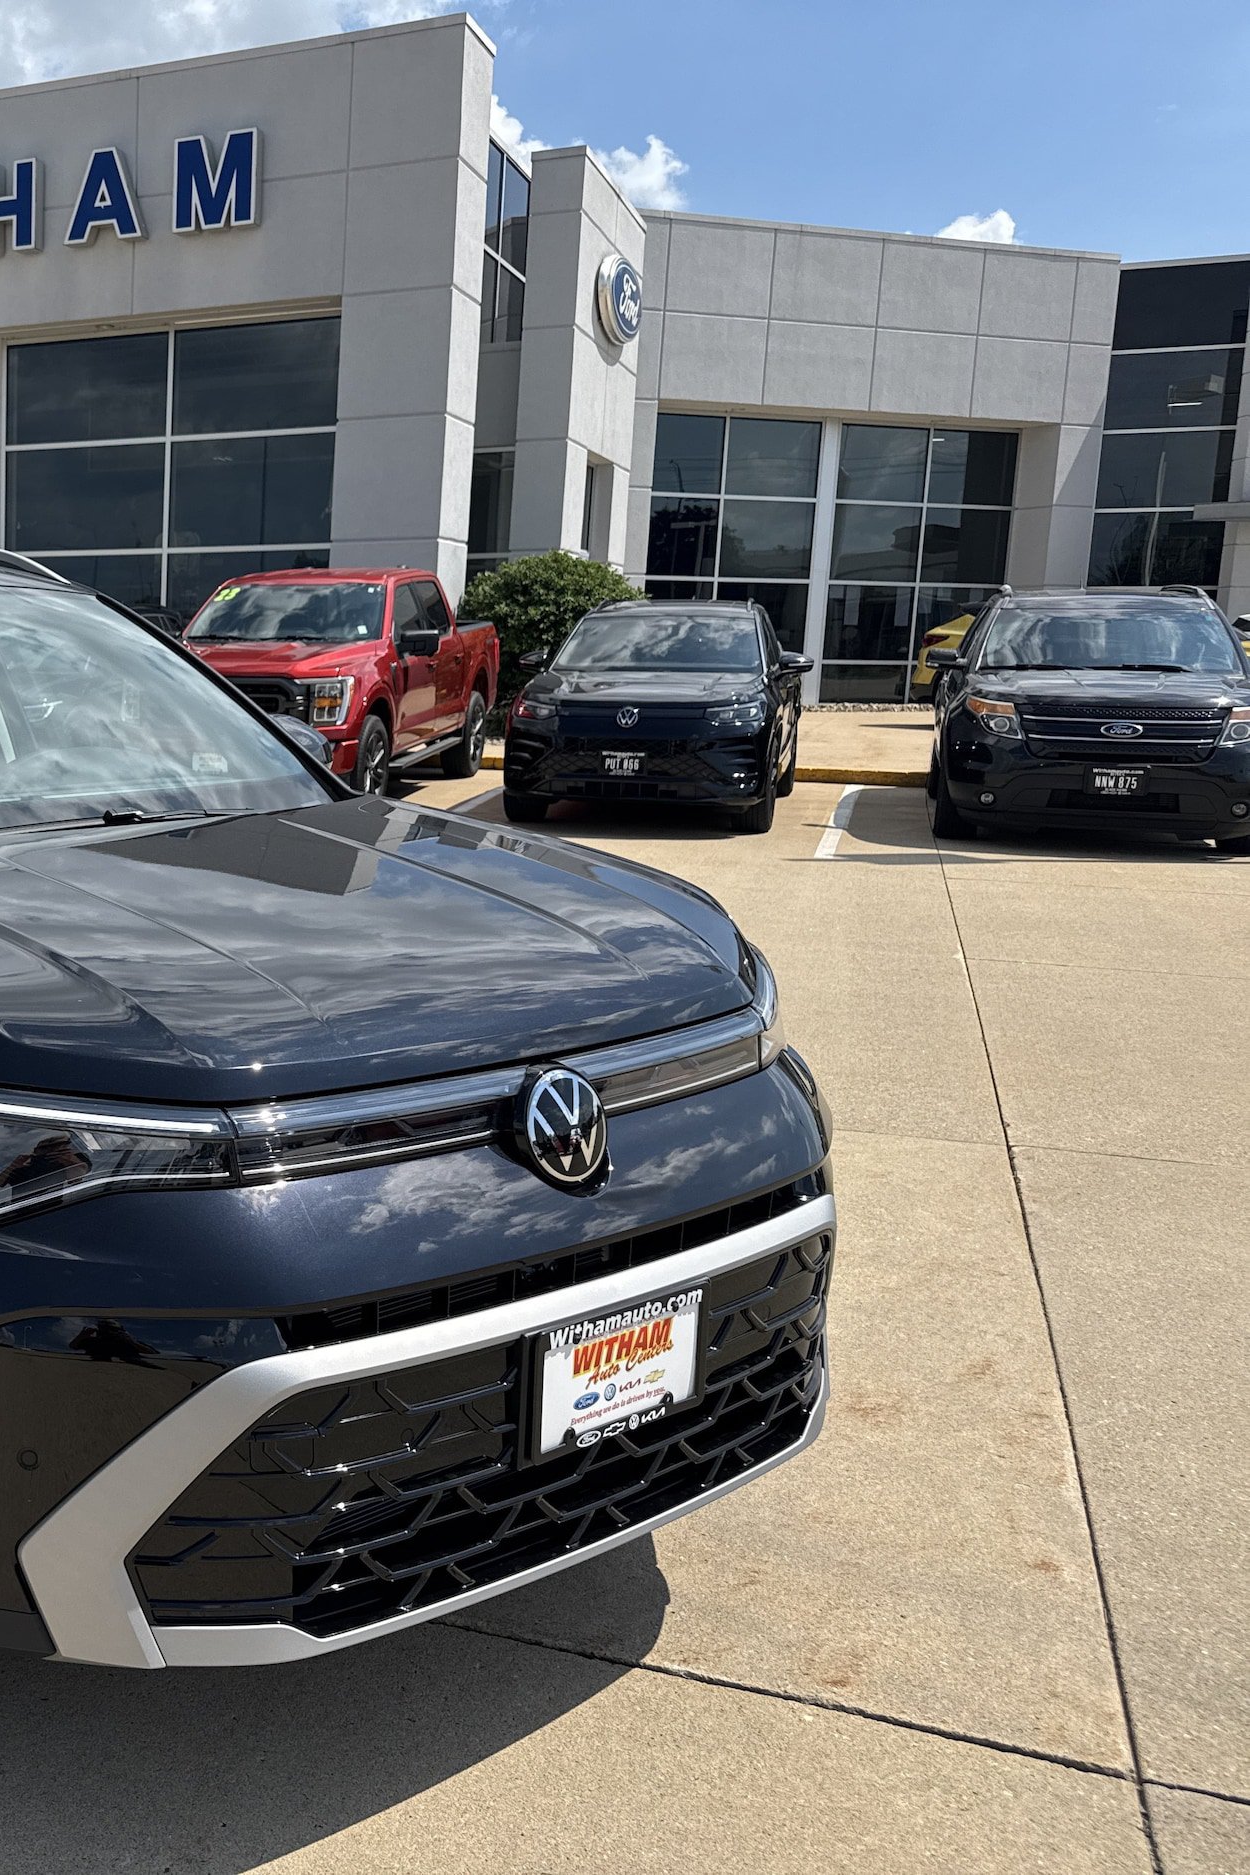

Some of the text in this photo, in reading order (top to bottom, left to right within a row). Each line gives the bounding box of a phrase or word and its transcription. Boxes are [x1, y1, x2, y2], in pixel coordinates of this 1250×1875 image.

[619, 273, 641, 328] Ford
[605, 758, 620, 770] PUT
[1094, 775, 1137, 789] NNW 875
[550, 1288, 703, 1350] Withamauto.com
[572, 1317, 672, 1377] WITHAM
[584, 1339, 675, 1390] Auto Centers
[570, 1407, 603, 1426] Everything
